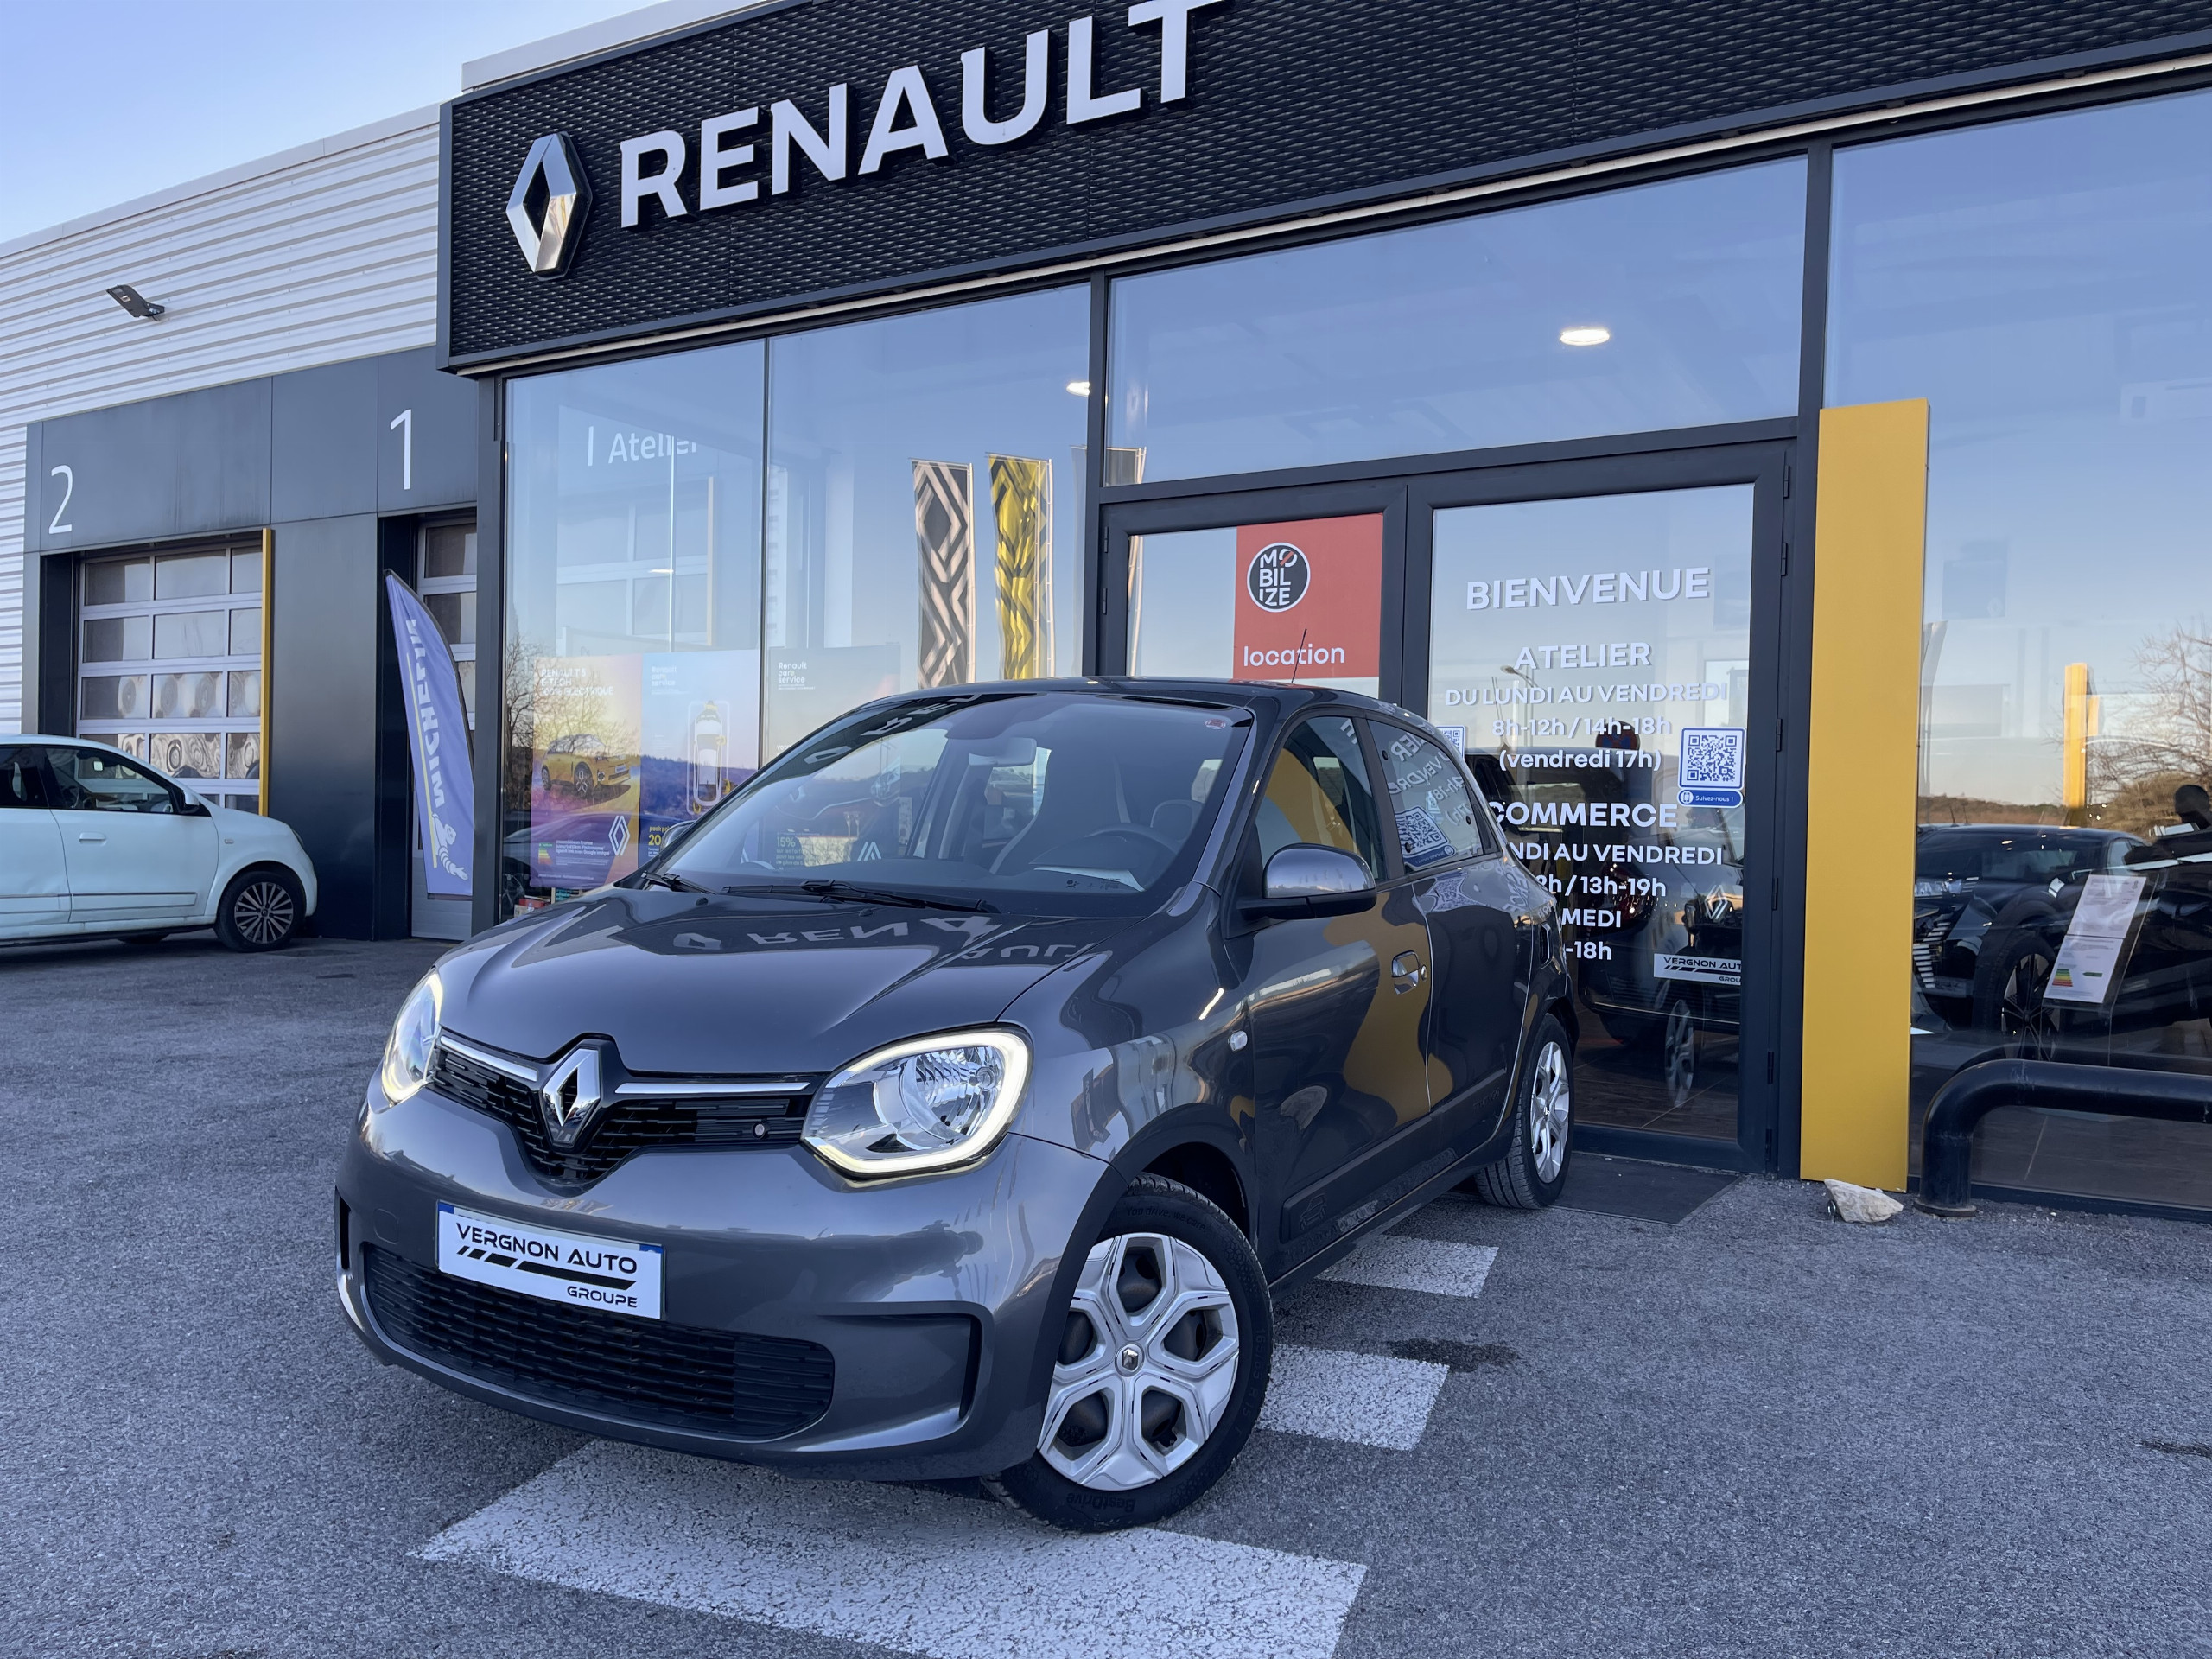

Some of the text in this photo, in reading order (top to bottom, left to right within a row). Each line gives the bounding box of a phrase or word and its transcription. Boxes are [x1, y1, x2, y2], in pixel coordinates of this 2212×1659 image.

[619, 0, 1223, 229] RENAULT
[389, 409, 413, 490] 1
[48, 465, 73, 534] 2
[1466, 567, 1710, 610] BIENVENUE
[1243, 643, 1345, 667] location
[1514, 642, 1652, 670] ATELIER
[1446, 683, 1727, 706] DU LUNDI AU VENDREDI
[1491, 718, 1566, 736] 8h-12h
[1585, 716, 1671, 736] 14h-18h
[1499, 749, 1662, 771] (vendredi 17h)
[1488, 802, 1678, 828] COMMERCE
[778, 836, 796, 848] 15%
[1509, 843, 1722, 865] NDI AU VENDREDI
[1580, 875, 1666, 897] 13h-19h
[1560, 908, 1622, 928] MEDI
[1564, 941, 1612, 960] -18h
[1663, 957, 1742, 970] VERGNON AUT
[456, 1223, 638, 1274] VERGNON AUTO
[567, 1286, 638, 1308] GROUPE
[1066, 1492, 1136, 1512] BestDrive
